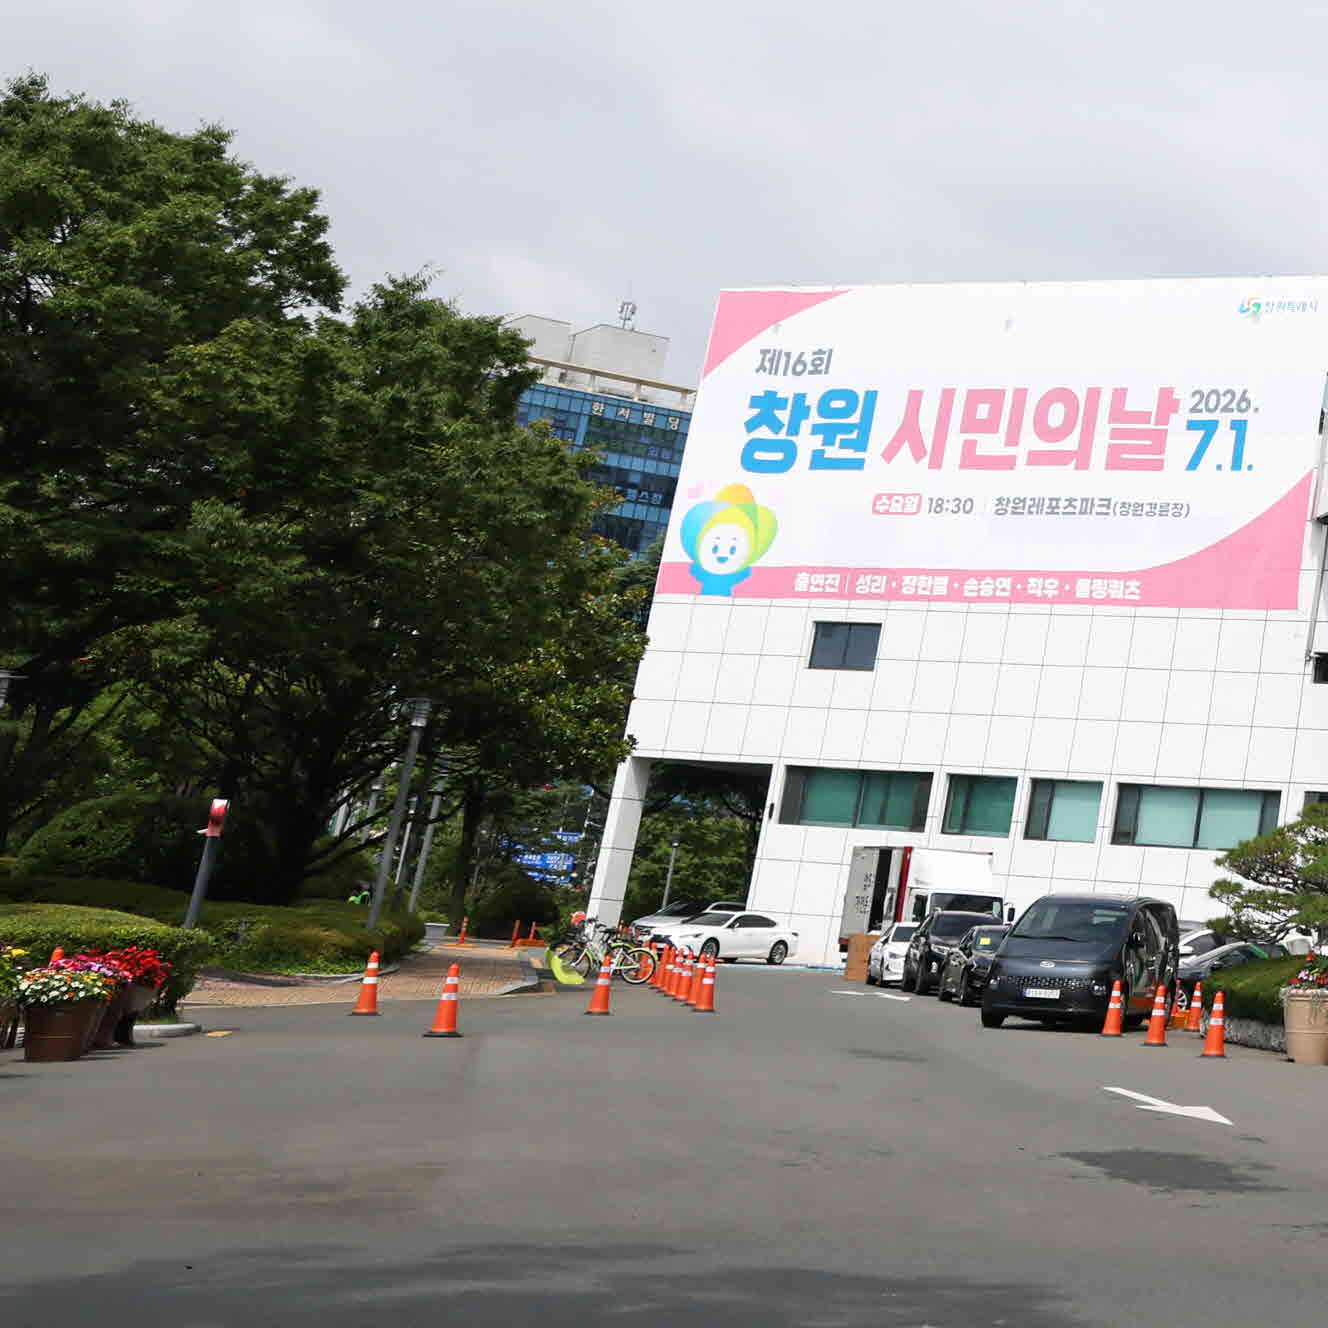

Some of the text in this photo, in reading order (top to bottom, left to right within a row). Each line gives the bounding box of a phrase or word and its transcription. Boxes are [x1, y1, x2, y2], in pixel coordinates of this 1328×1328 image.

[755, 347, 833, 377] 제16회
[1188, 389, 1260, 415] 2026.
[740, 387, 879, 474] 창원
[875, 495, 919, 514] 수요일
[927, 497, 974, 514] 18:30
